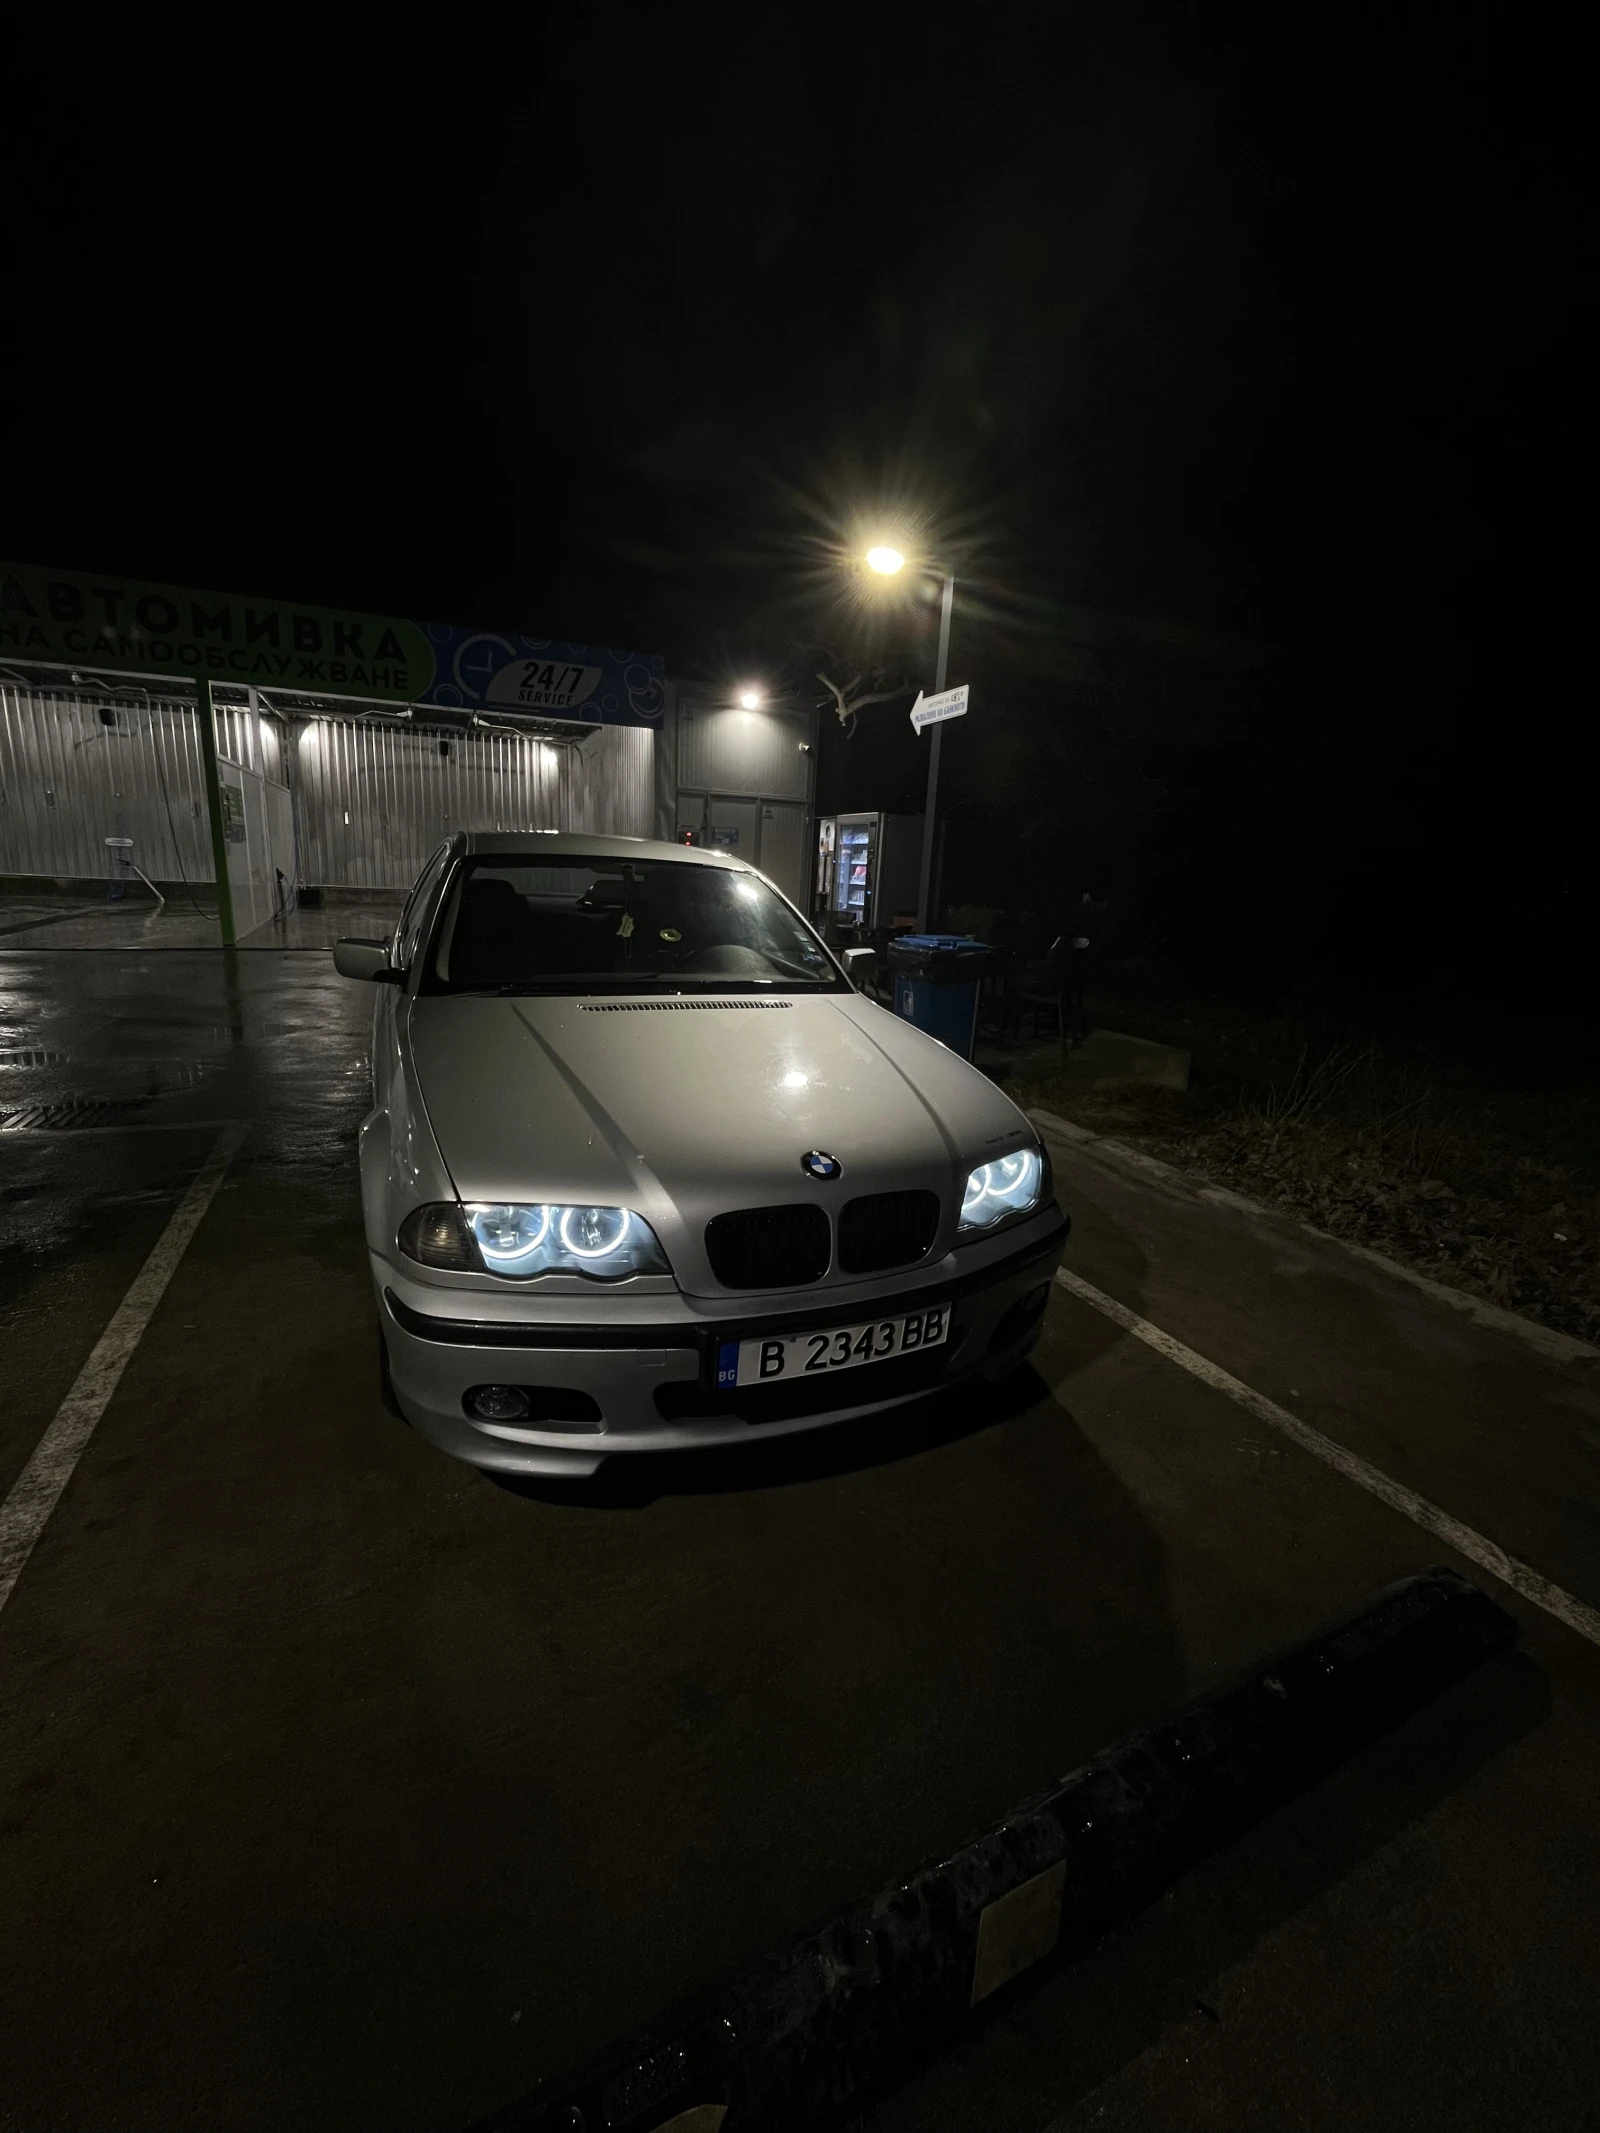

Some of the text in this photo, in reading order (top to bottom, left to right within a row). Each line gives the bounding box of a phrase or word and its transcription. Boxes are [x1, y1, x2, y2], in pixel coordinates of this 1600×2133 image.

[0, 573, 409, 665] АВТОМИВКА
[63, 628, 410, 690] САМООБСЛУЖВАНЕ
[519, 661, 584, 694] 24/7
[518, 689, 575, 706] SERVICE
[759, 1309, 943, 1379] B 2343 BB
[718, 1369, 736, 1382] BG
